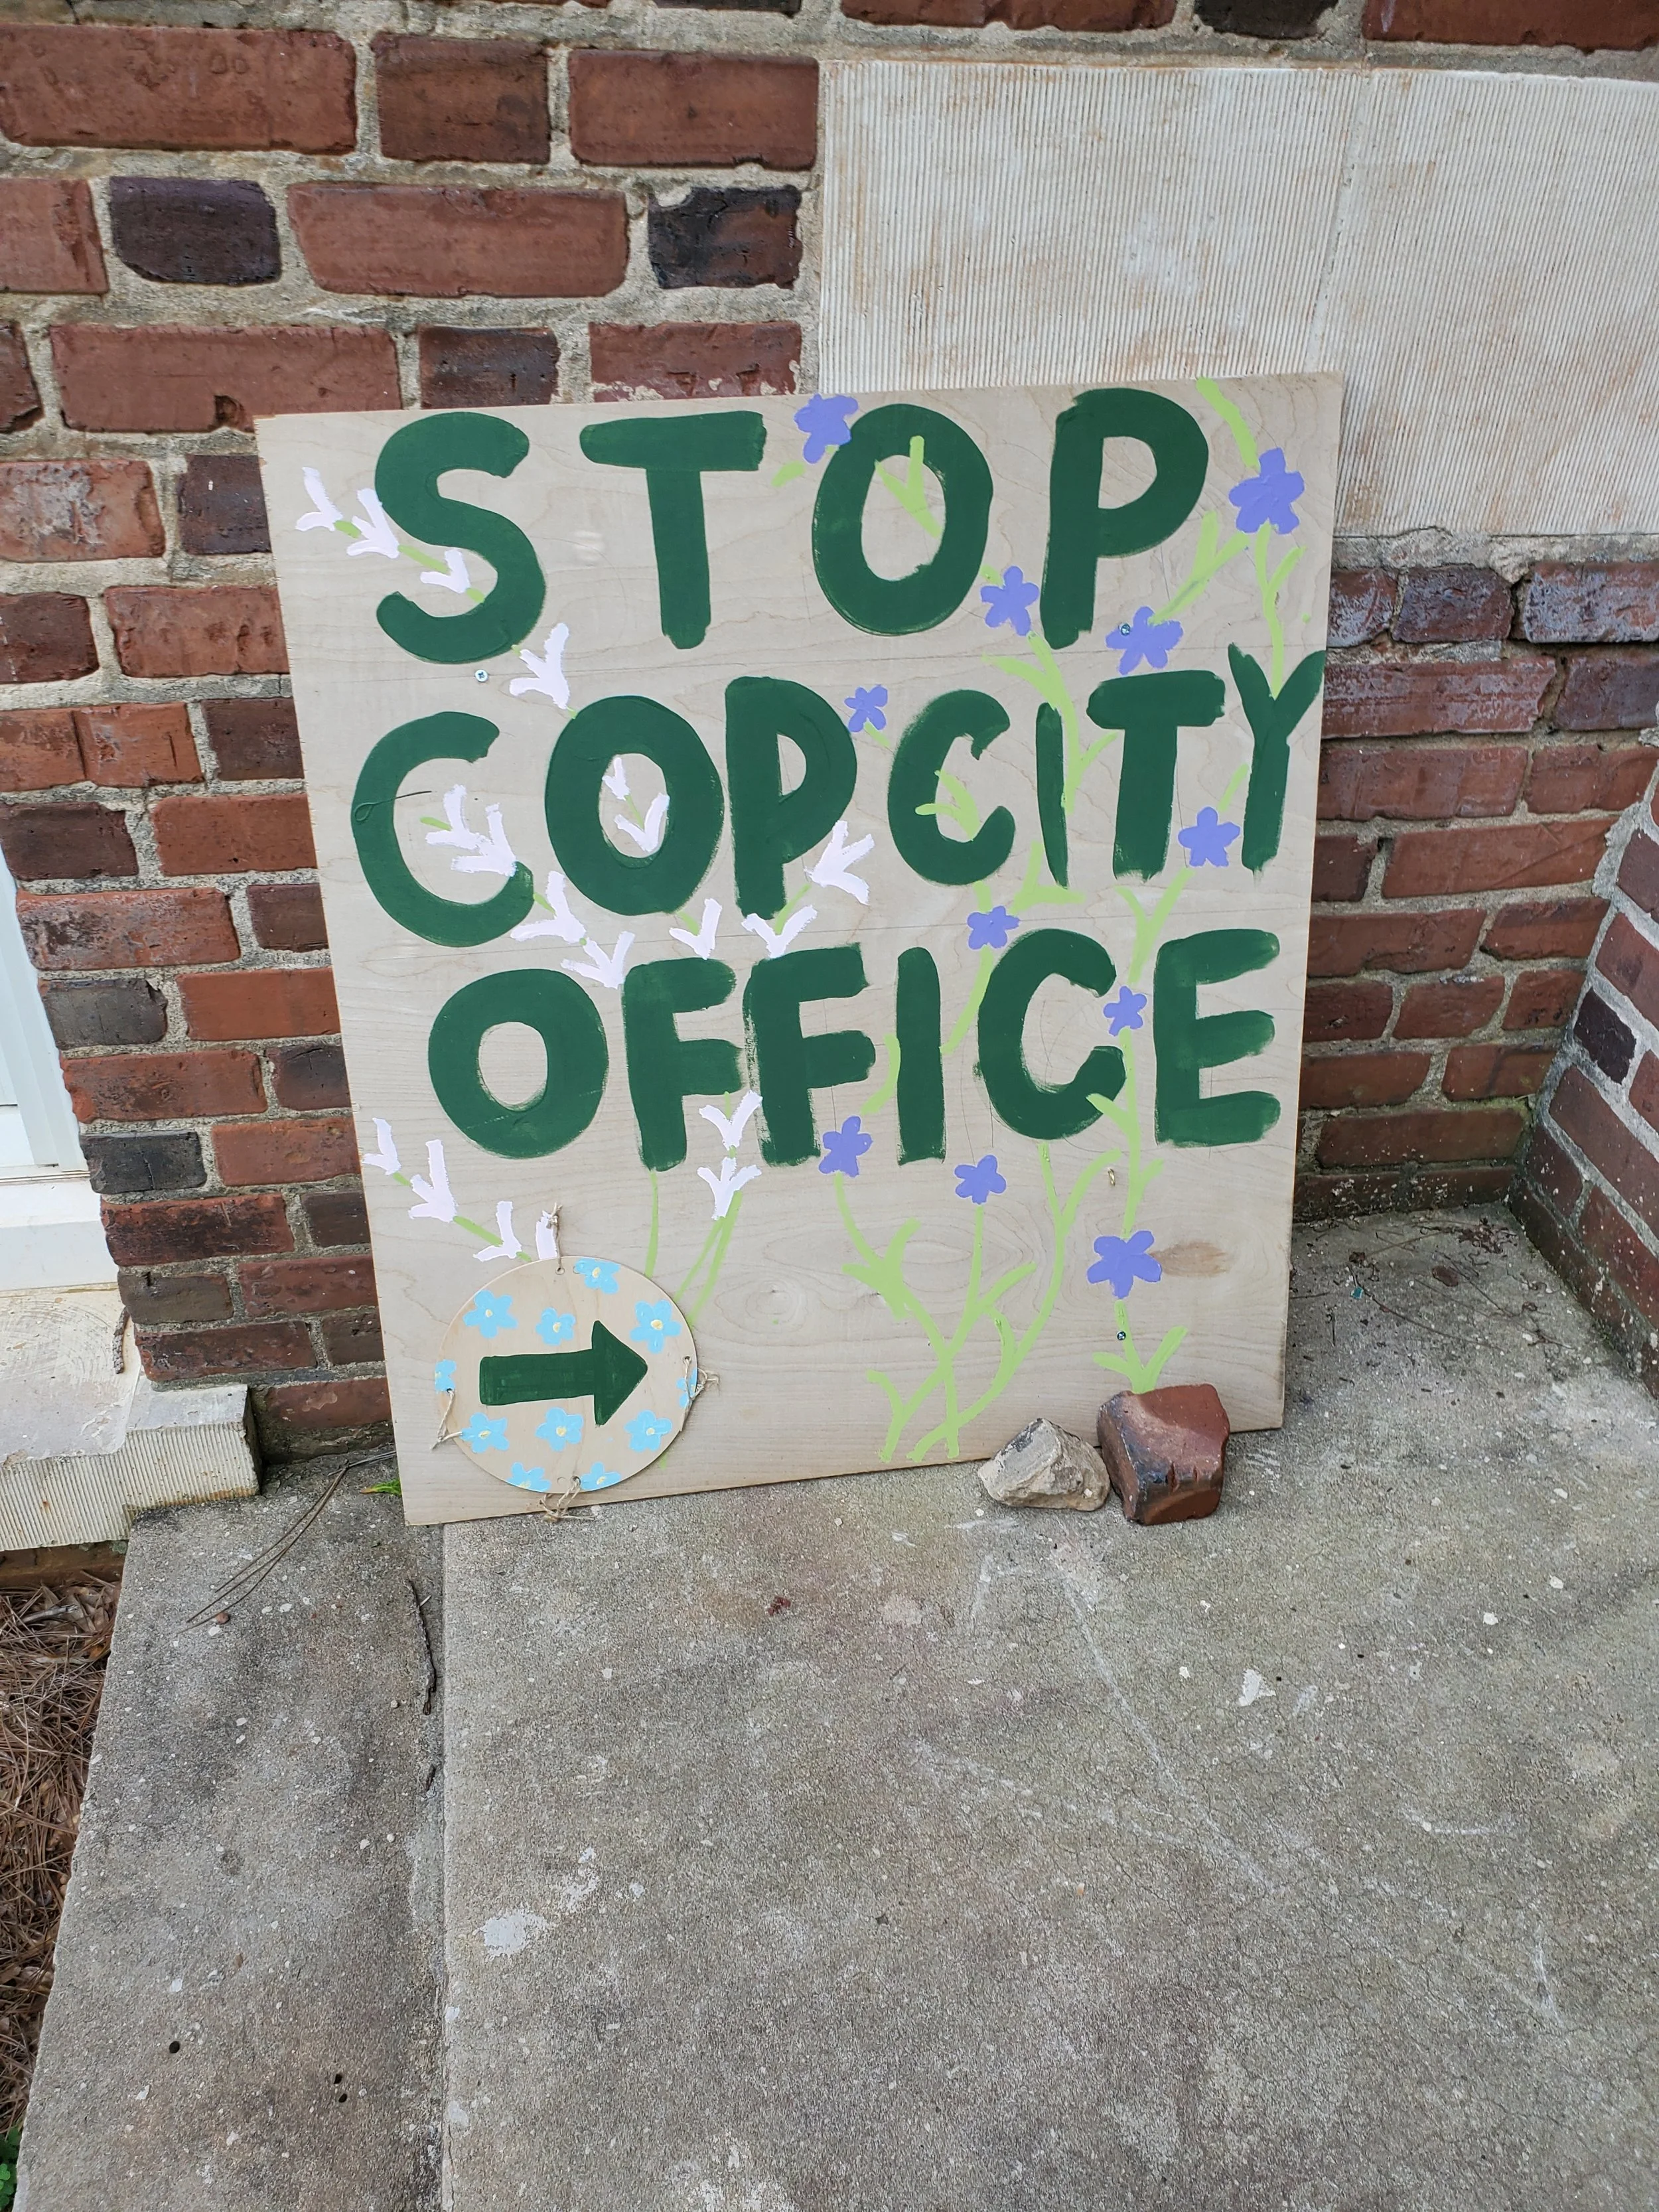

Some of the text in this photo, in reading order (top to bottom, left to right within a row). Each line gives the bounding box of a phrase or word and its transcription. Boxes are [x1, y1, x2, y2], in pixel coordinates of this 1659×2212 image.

[374, 387, 1208, 664] STOP
[350, 644, 1327, 947] COP CITY
[427, 928, 1281, 1171] OFFICE
